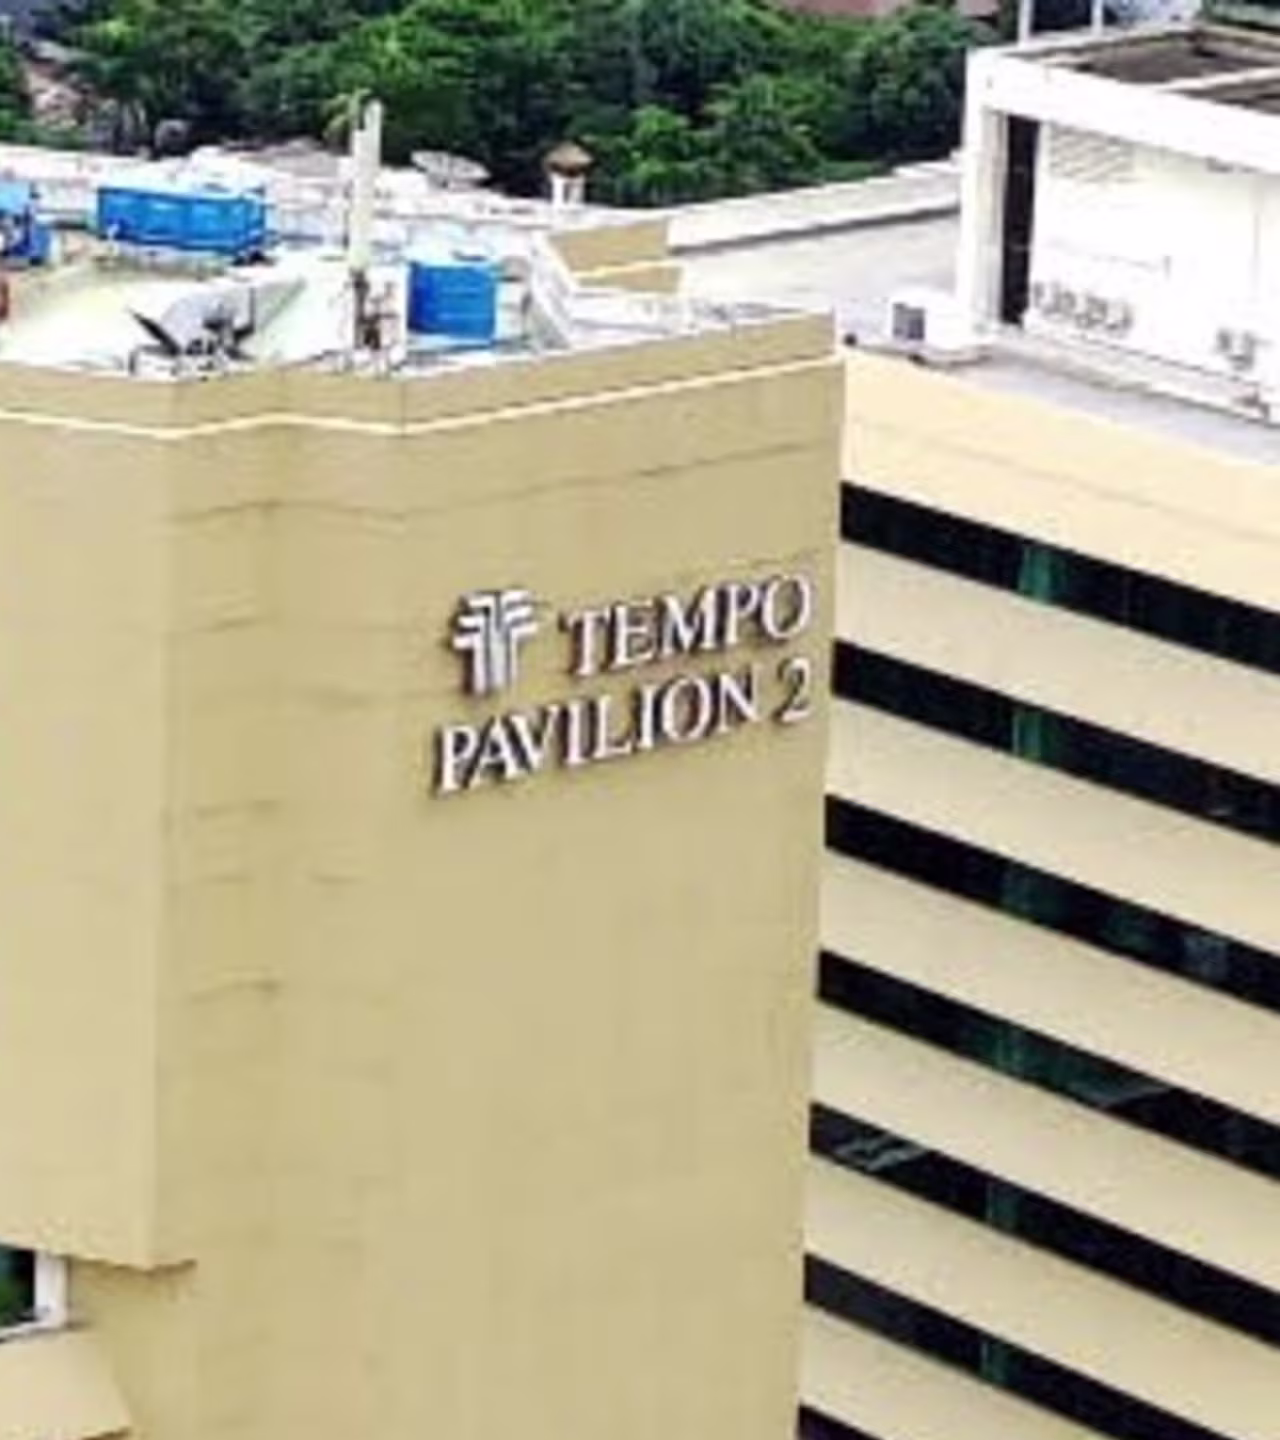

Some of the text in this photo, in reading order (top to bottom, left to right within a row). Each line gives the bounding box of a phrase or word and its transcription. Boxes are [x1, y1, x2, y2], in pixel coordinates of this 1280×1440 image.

[560, 573, 813, 678] TEMPO
[437, 657, 812, 795] PAVILION 2
